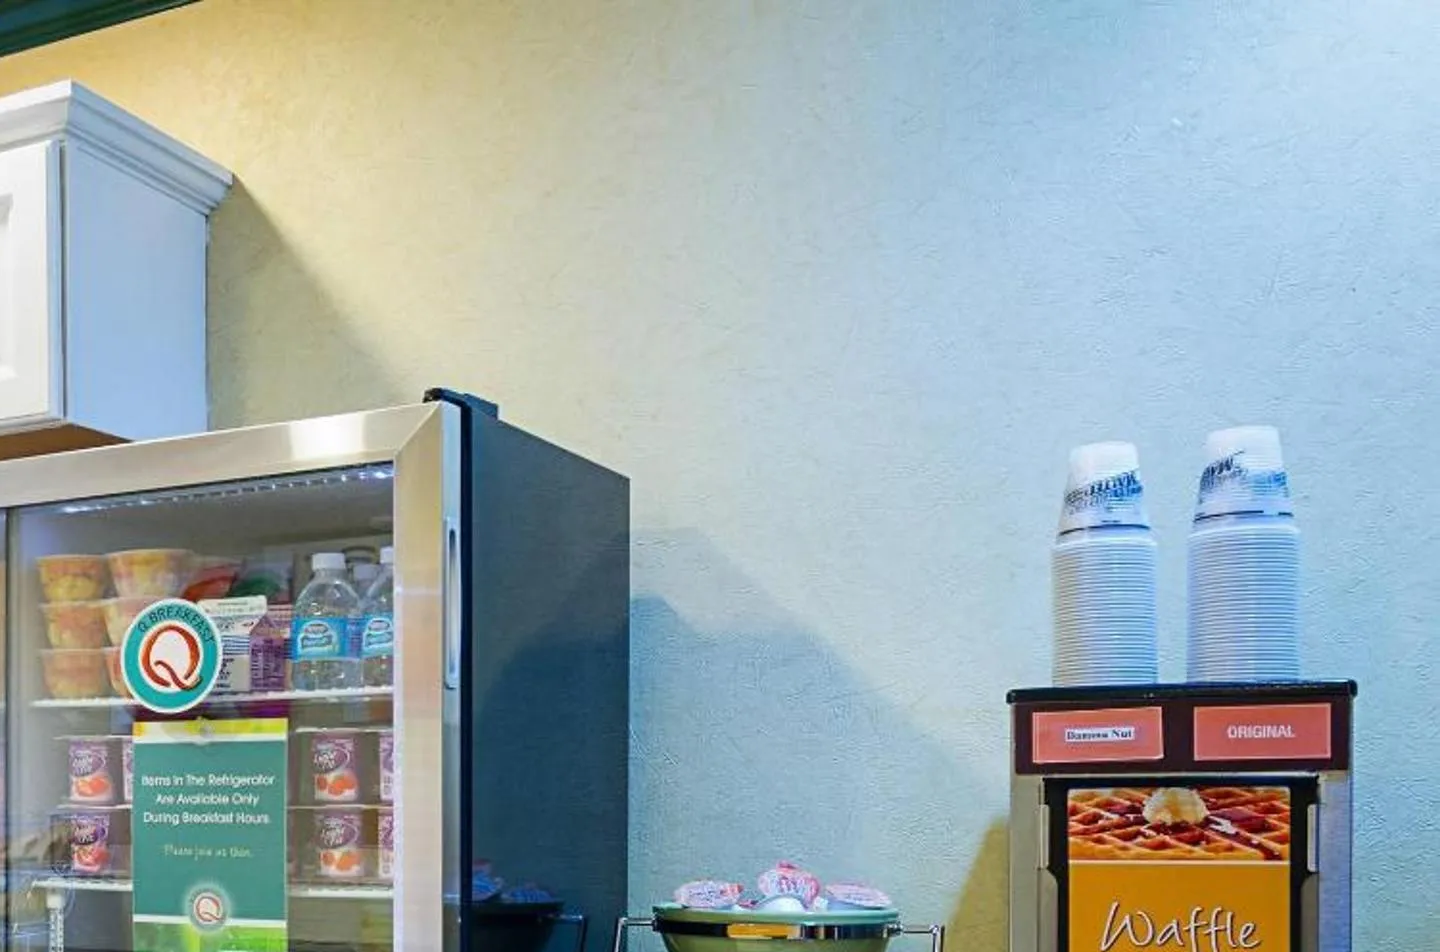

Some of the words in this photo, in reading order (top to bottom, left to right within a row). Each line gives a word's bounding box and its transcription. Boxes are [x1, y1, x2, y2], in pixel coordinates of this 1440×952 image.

[140, 625, 204, 692] Q
[1111, 727, 1133, 739] Nut
[1227, 724, 1296, 739] ORIGINAL
[141, 775, 171, 787] Items
[186, 774, 206, 787] The
[208, 773, 276, 789] Refrigerator
[156, 793, 174, 805] Are
[175, 793, 230, 805] Available
[231, 792, 260, 807] Only
[143, 812, 180, 826] During
[181, 812, 234, 824] Breakfast
